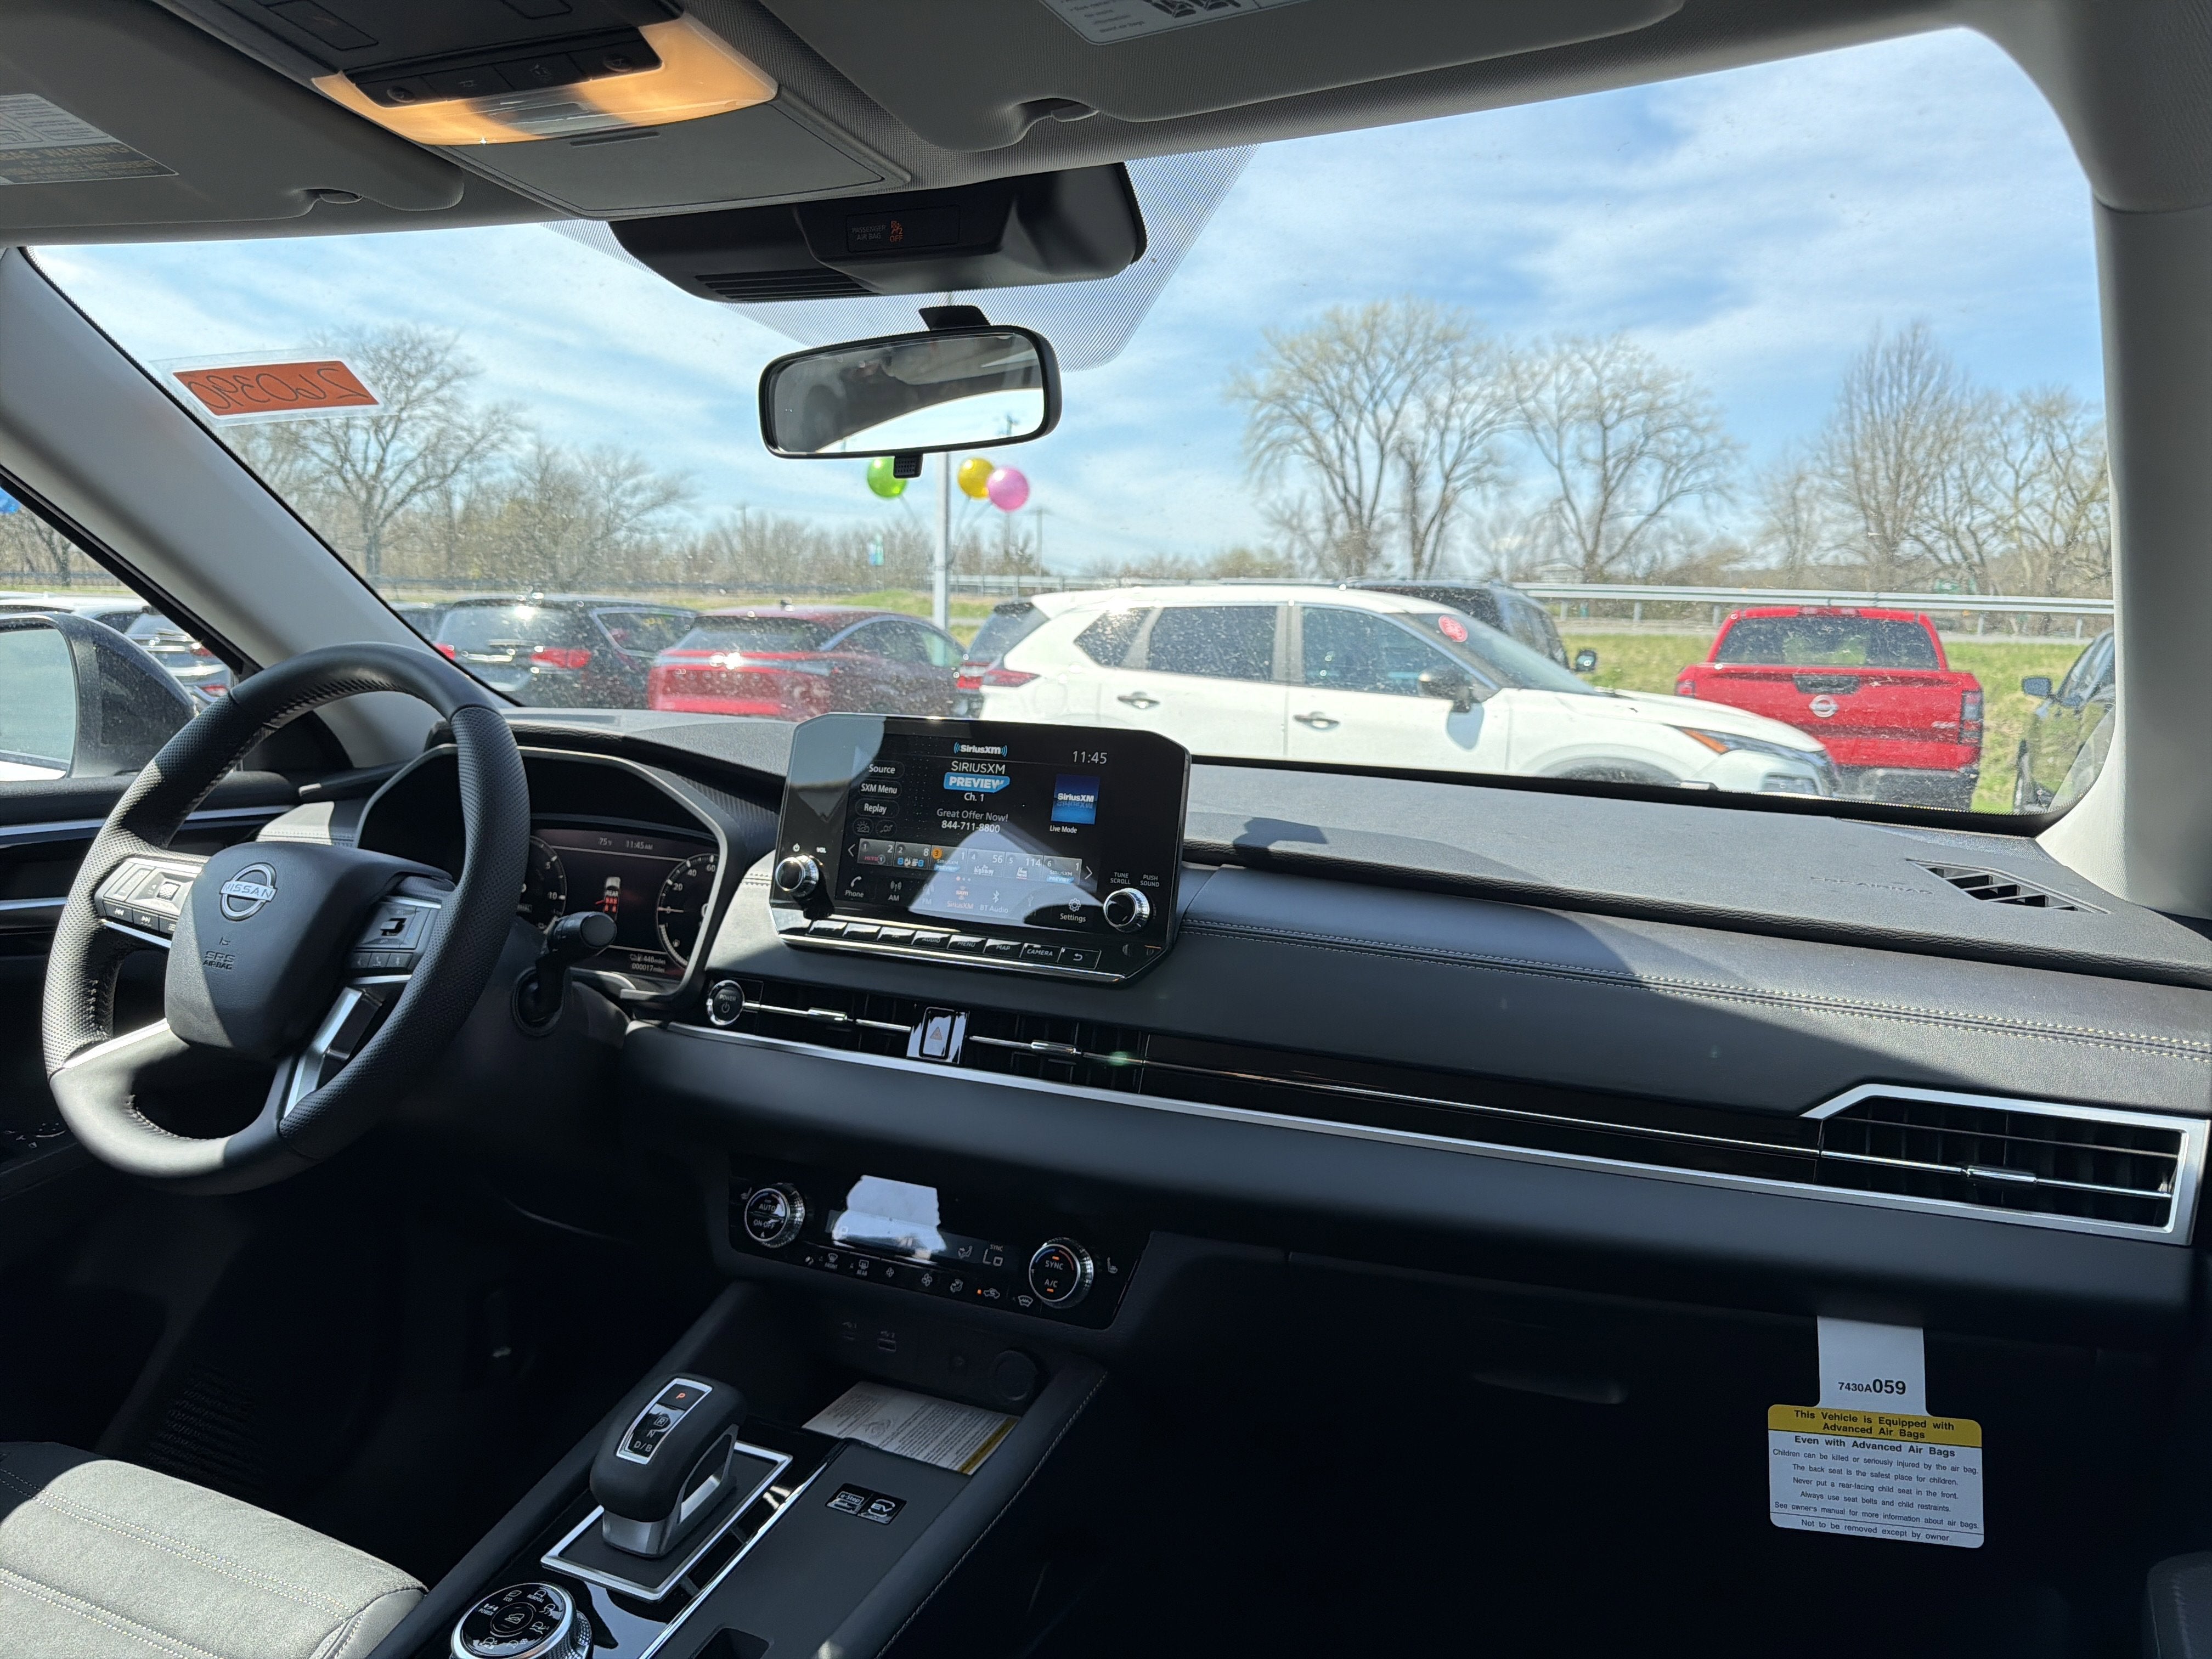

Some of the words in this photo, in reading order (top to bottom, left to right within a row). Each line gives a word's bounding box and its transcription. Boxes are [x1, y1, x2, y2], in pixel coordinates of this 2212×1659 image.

[852, 225, 886, 234] PASSENGER
[1073, 751, 1108, 764] 11:45
[868, 764, 896, 775] Source
[951, 761, 1005, 775] SIRIUSXM
[949, 776, 1005, 789] PREVIEW
[861, 783, 877, 793] SXM
[878, 784, 898, 794] Menu
[964, 792, 977, 802] Ch.
[980, 793, 984, 802] 1
[1057, 793, 1094, 803] SiriusXM
[864, 803, 887, 815] Replay
[936, 808, 960, 818] Great
[961, 810, 984, 820] Offer
[985, 812, 1008, 822] Now!
[941, 820, 1001, 833] 844-711-8800
[887, 845, 893, 854] 2
[923, 848, 929, 856] 8
[961, 852, 965, 860] 1
[992, 855, 1003, 864] 56
[1026, 858, 1041, 867] 114
[1075, 862, 1080, 871] 1
[224, 883, 274, 899] NISSAN
[673, 883, 683, 891] 20
[548, 891, 557, 900] 10
[845, 890, 864, 898] Phone
[1060, 913, 1086, 923] Settings
[202, 960, 233, 970] AIRBAG
[1045, 1261, 1064, 1271] SYNC
[1044, 1279, 1058, 1288] A/C
[1837, 1378, 1907, 1396] 7430A059
[1793, 1409, 1816, 1419] This
[1820, 1410, 1858, 1423] Vehicle
[1863, 1415, 1874, 1424] is
[1878, 1415, 1927, 1429] Equipped
[1932, 1421, 1954, 1431] with
[646, 1430, 656, 1438] N
[1822, 1422, 1872, 1435] Advanced
[1878, 1426, 1894, 1436] Air
[1899, 1427, 1925, 1440] Bags
[634, 1441, 653, 1453] D/B
[1795, 1435, 1819, 1445] Even
[1824, 1438, 1846, 1448] with
[1851, 1440, 1902, 1452] Advanced
[1908, 1444, 1923, 1454] Air
[1929, 1446, 1956, 1458] Bags
[1773, 1448, 1801, 1458] Children
[1819, 1452, 1829, 1460] be
[1831, 1453, 1849, 1462] killed
[1863, 1457, 1893, 1468] seriously
[1896, 1459, 1920, 1469] injured
[1923, 1462, 1932, 1471] by
[1936, 1463, 1947, 1471] the
[1963, 1465, 1979, 1475] bag.
[1792, 1463, 1805, 1471] The
[1808, 1464, 1825, 1473] back
[1855, 1469, 1867, 1477] the
[1870, 1471, 1891, 1480] safest
[1894, 1473, 1913, 1481] place
[1929, 1476, 1958, 1486] children.
[1793, 1476, 1813, 1485] Never
[1838, 1482, 1875, 1493] rear-facing
[1877, 1485, 1894, 1493] child
[1916, 1488, 1922, 1496] in
[1940, 1491, 1959, 1499] front.
[1800, 1491, 1824, 1500] Always
[1861, 1496, 1878, 1505] belts
[1898, 1500, 1914, 1509] child
[1917, 1503, 1951, 1512] restraints.
[871, 1503, 893, 1512] EV
[1774, 1501, 1788, 1510] See
[1791, 1504, 1818, 1513] owner's
[1820, 1507, 1846, 1515] manual
[1882, 1512, 1921, 1523] information
[1924, 1517, 1944, 1526] about
[1960, 1520, 1980, 1530] bags.
[1801, 1519, 1815, 1527] Not
[1830, 1522, 1840, 1530] be
[1844, 1522, 1877, 1534] removed
[1881, 1529, 1908, 1538] except
[1911, 1530, 1922, 1540] by
[1925, 1533, 1950, 1542] owner
[527, 1594, 545, 1603] NORMAL
[478, 1608, 494, 1616] POWER
